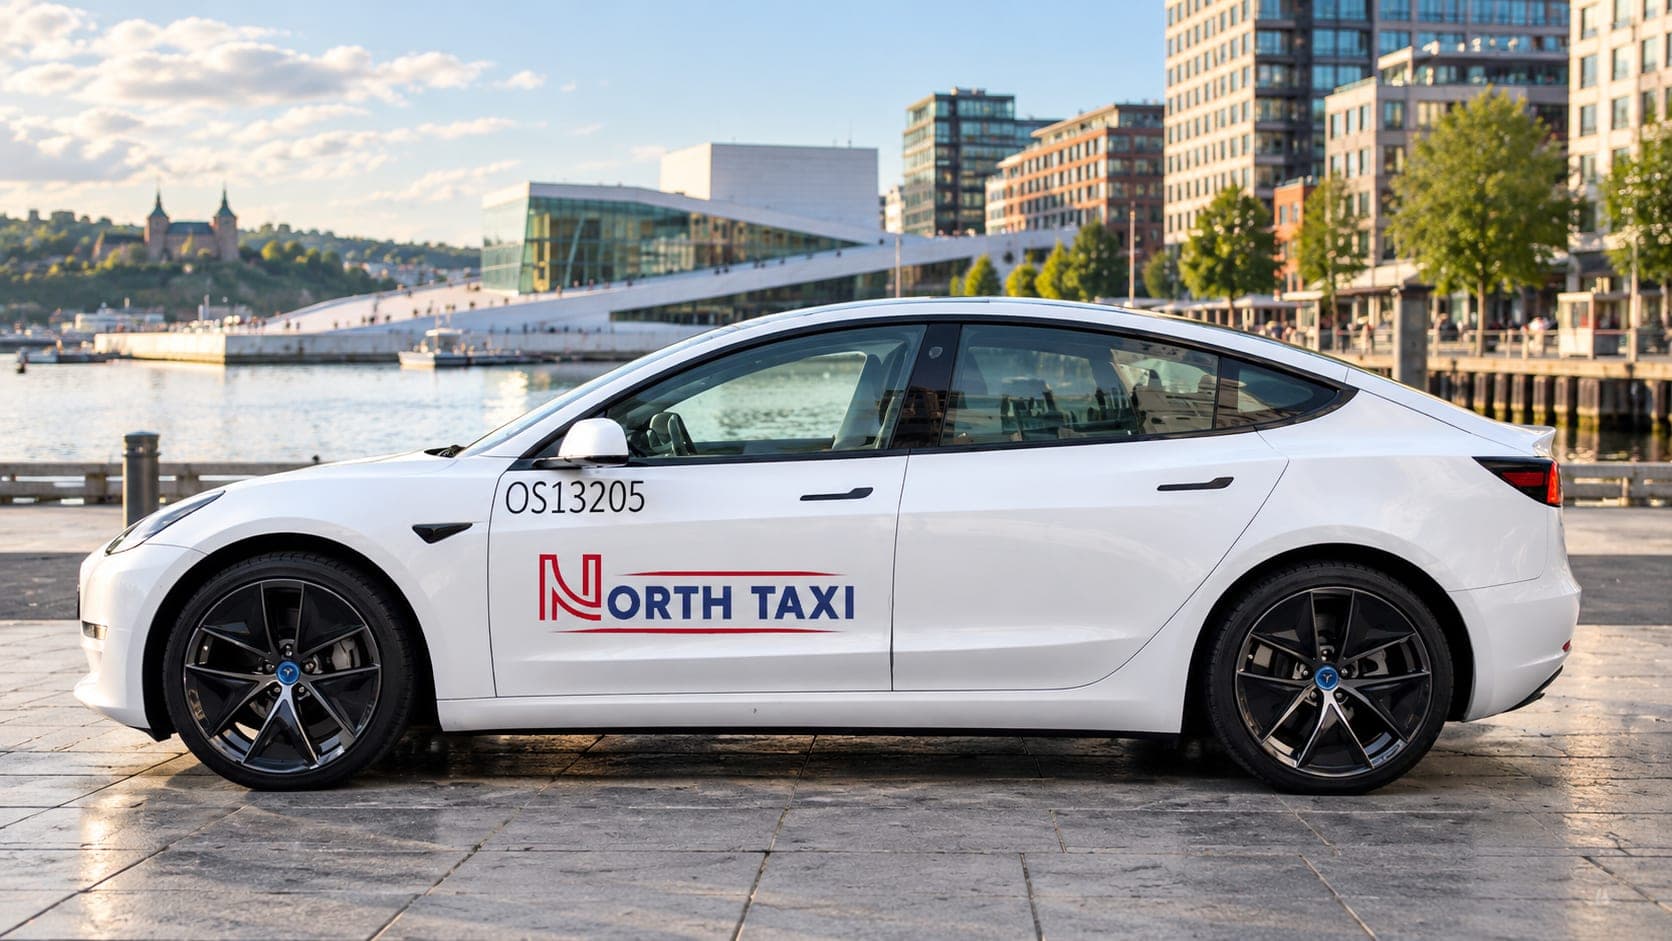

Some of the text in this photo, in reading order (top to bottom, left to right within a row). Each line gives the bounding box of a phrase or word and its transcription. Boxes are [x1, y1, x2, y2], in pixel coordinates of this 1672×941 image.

[505, 480, 645, 514] OS13205
[539, 554, 854, 621] NORTH TAXI
